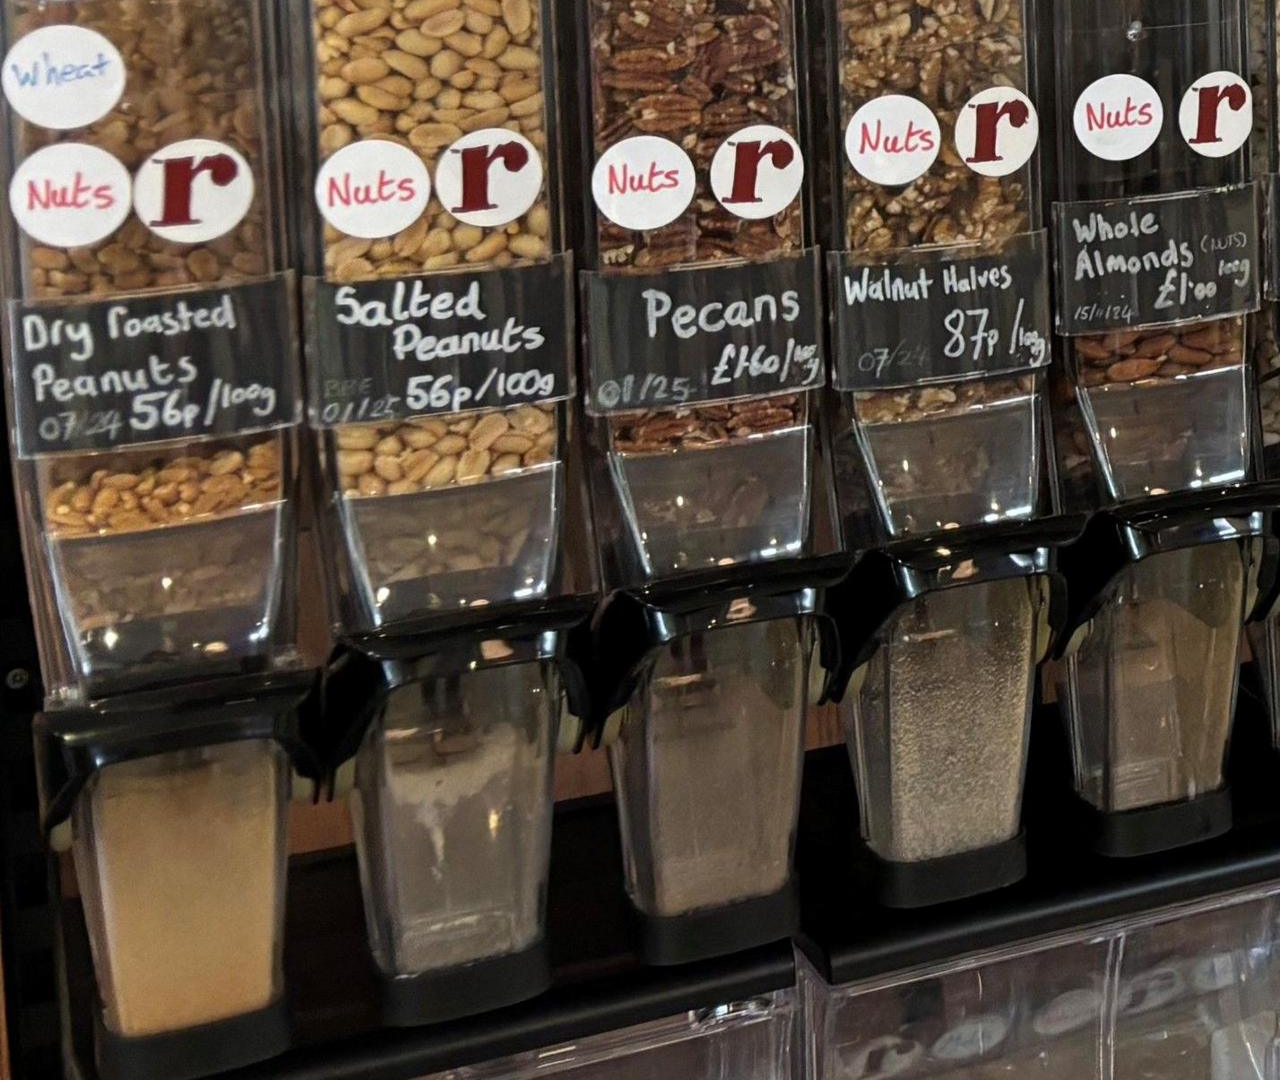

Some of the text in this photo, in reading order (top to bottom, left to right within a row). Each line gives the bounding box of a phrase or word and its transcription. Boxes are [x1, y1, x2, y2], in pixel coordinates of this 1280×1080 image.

[11, 53, 111, 88] Wheat
[965, 98, 1030, 164] r
[1086, 97, 1153, 132] Nuts
[1188, 83, 1247, 145] r
[858, 119, 936, 155] Nuts
[27, 172, 116, 212] Nuts
[149, 152, 240, 228] r
[327, 170, 416, 208] Nuts
[450, 140, 530, 214] r
[608, 161, 681, 195] Nuts
[721, 138, 795, 205] r
[1072, 212, 1160, 244] Whole
[1073, 238, 1195, 282] Almonds
[334, 280, 488, 327] Salted
[843, 265, 1014, 306] Walnut Halves
[22, 294, 237, 361] Dry roasted
[641, 288, 800, 339] Pecans
[392, 317, 546, 361] Peanuts
[31, 355, 198, 403] Peanuts
[406, 367, 556, 413] 56p/100g
